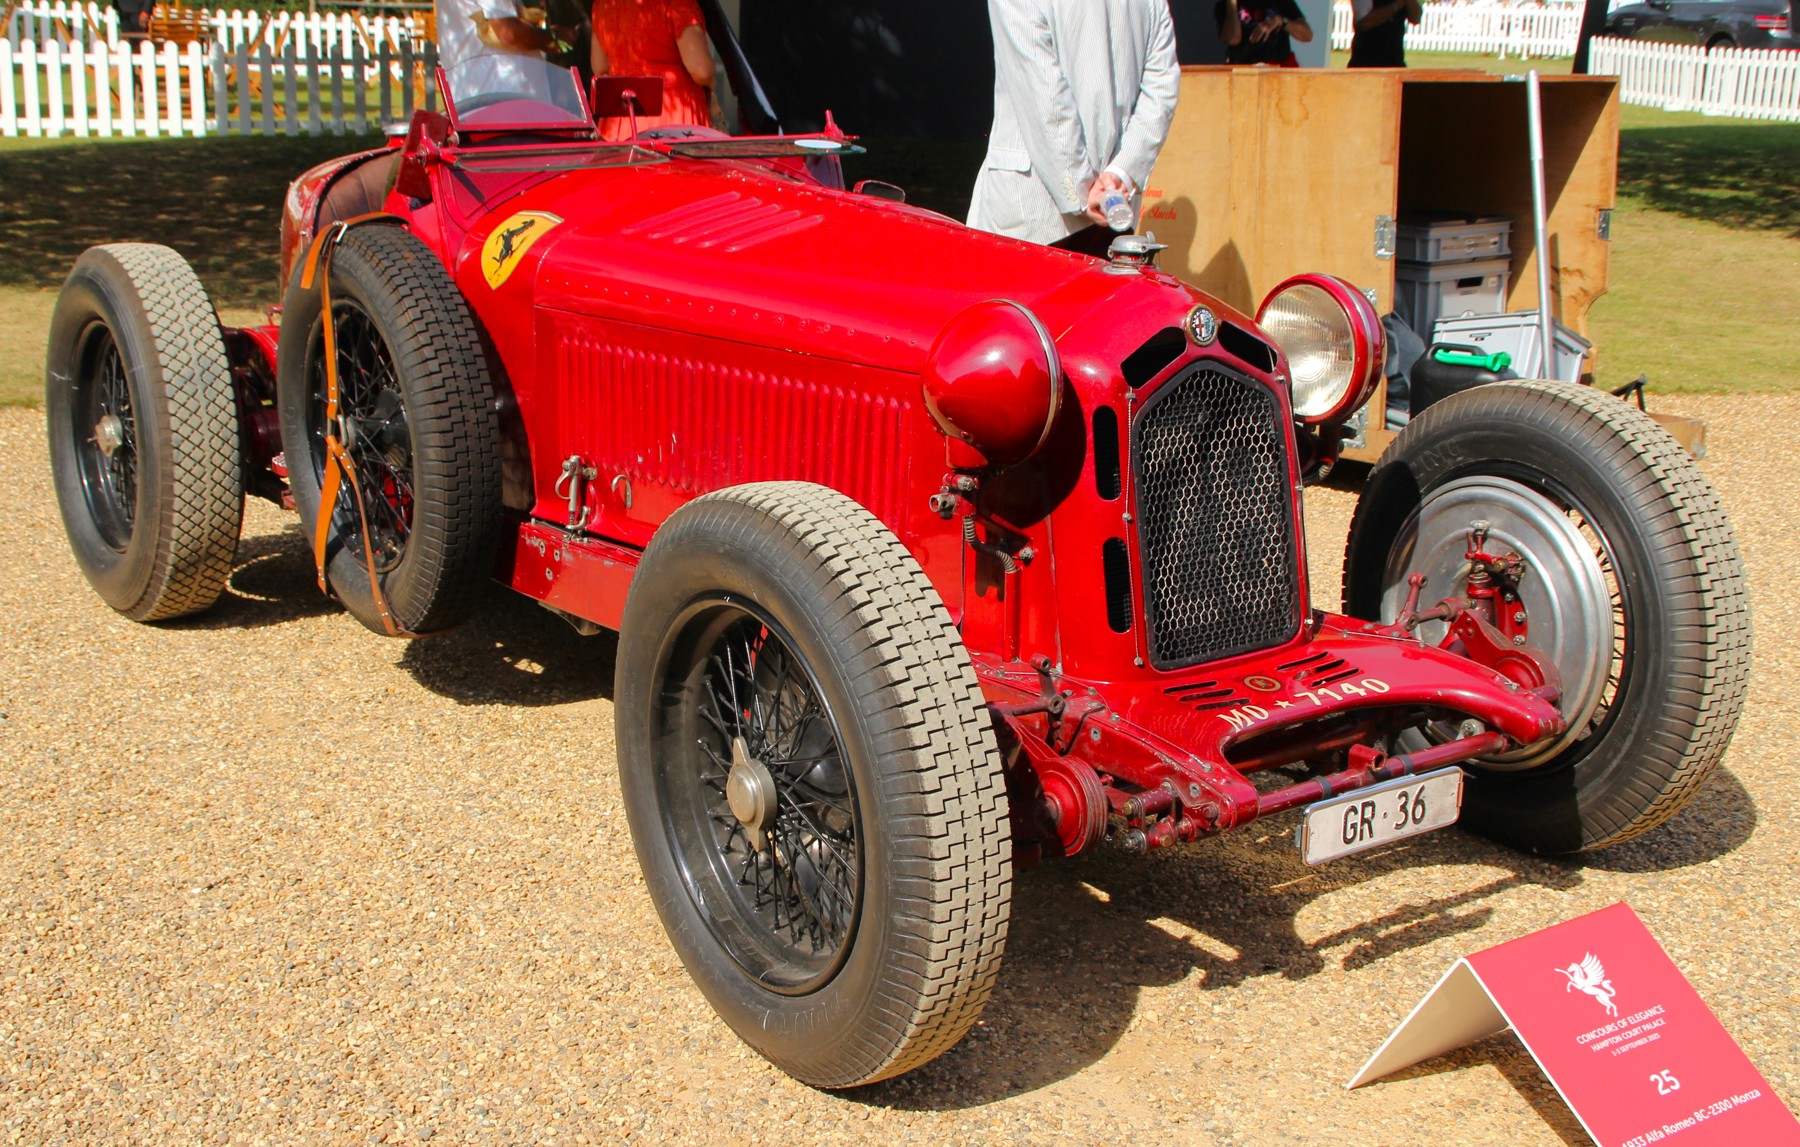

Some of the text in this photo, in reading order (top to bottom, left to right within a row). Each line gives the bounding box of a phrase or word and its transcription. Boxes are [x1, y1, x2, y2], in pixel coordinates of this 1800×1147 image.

[1216, 678, 1390, 733] MO 7140
[1341, 782, 1426, 844] GR 36
[1576, 1004, 1666, 1044] CONCOURS OF ELEGANCE
[1591, 1017, 1666, 1052] HAMPTON COURT PALACE
[1619, 1036, 1648, 1053] SEPTEMBER
[1649, 1069, 1680, 1095] 25
[1645, 1129, 1665, 1144] Alfa
[1662, 1117, 1696, 1136] Romeo
[1693, 1099, 1733, 1122] 8C-2300
[1730, 1089, 1761, 1107] Monza
